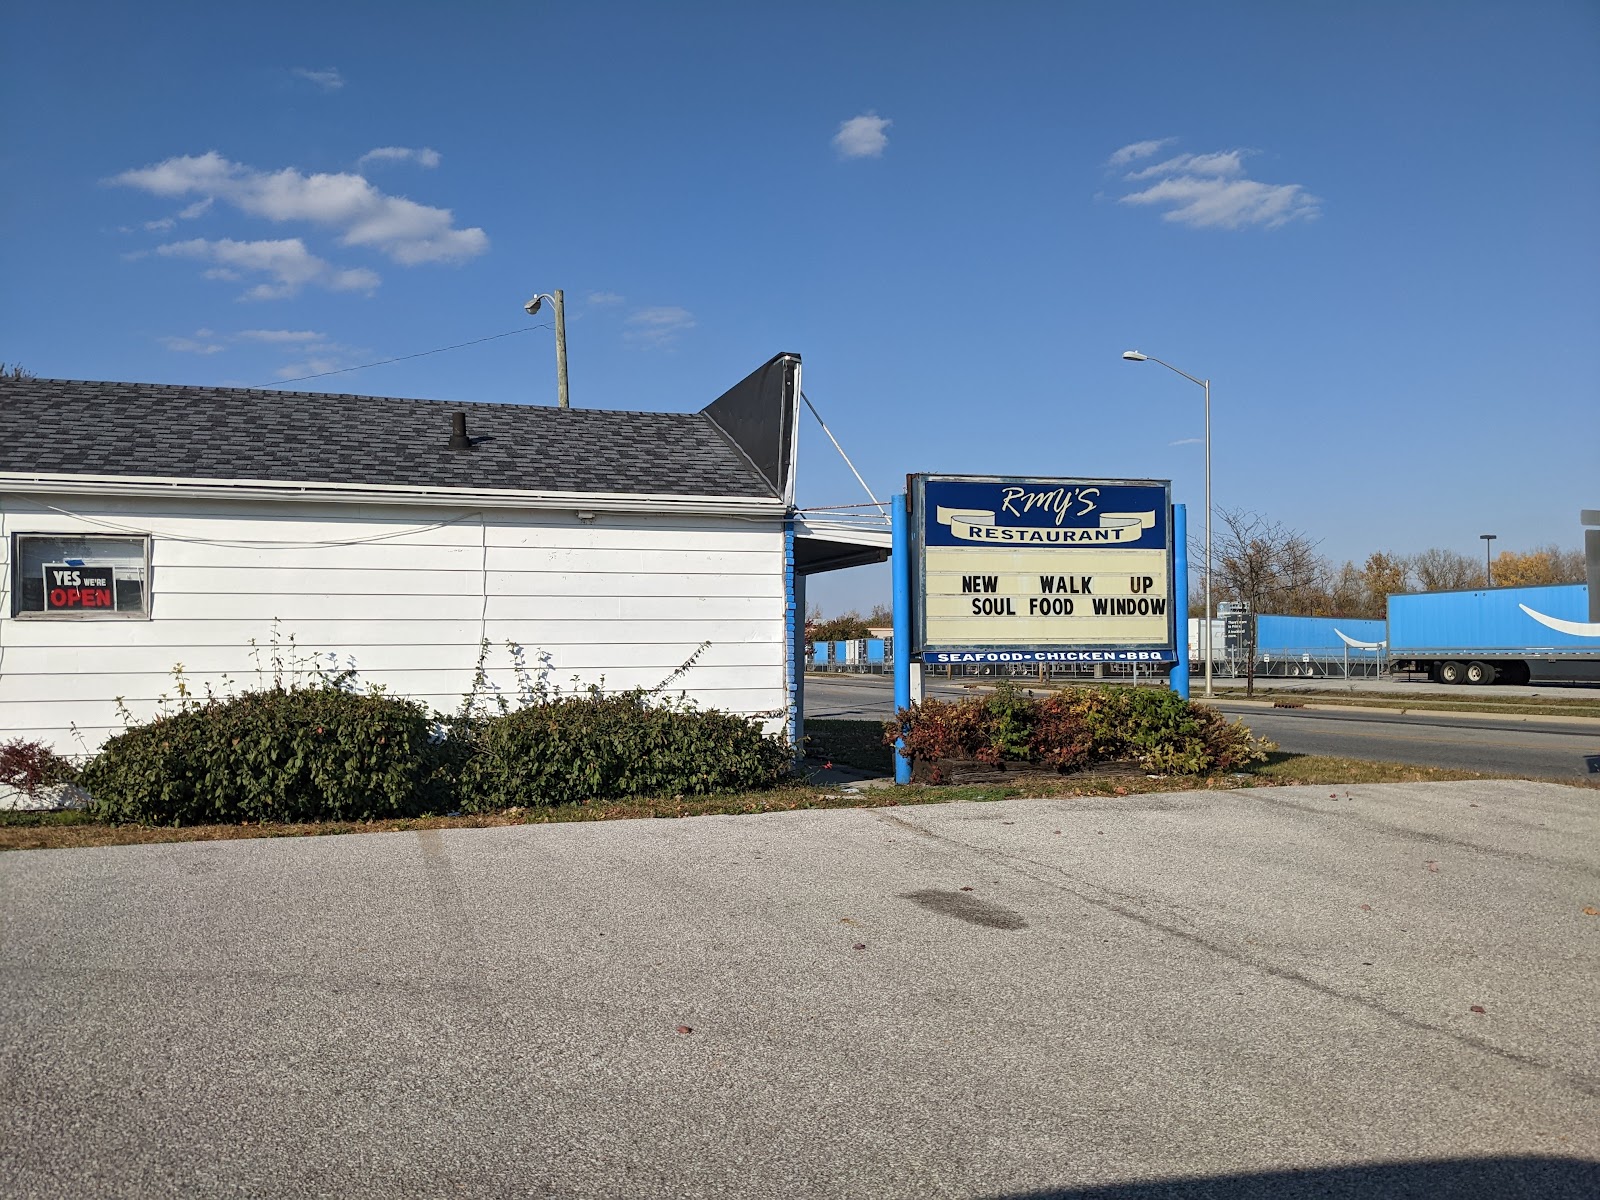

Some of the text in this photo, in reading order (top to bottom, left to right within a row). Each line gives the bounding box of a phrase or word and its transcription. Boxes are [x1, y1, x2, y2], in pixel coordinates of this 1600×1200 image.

[969, 526, 1124, 542] RESTAURANT
[53, 571, 107, 587] YES WE'RE
[962, 575, 1153, 594] NEW WALK UP
[51, 588, 111, 607] OPEN
[972, 598, 1166, 616] SOUL FOOD WINDOW
[1034, 651, 1116, 661] CHICKEN
